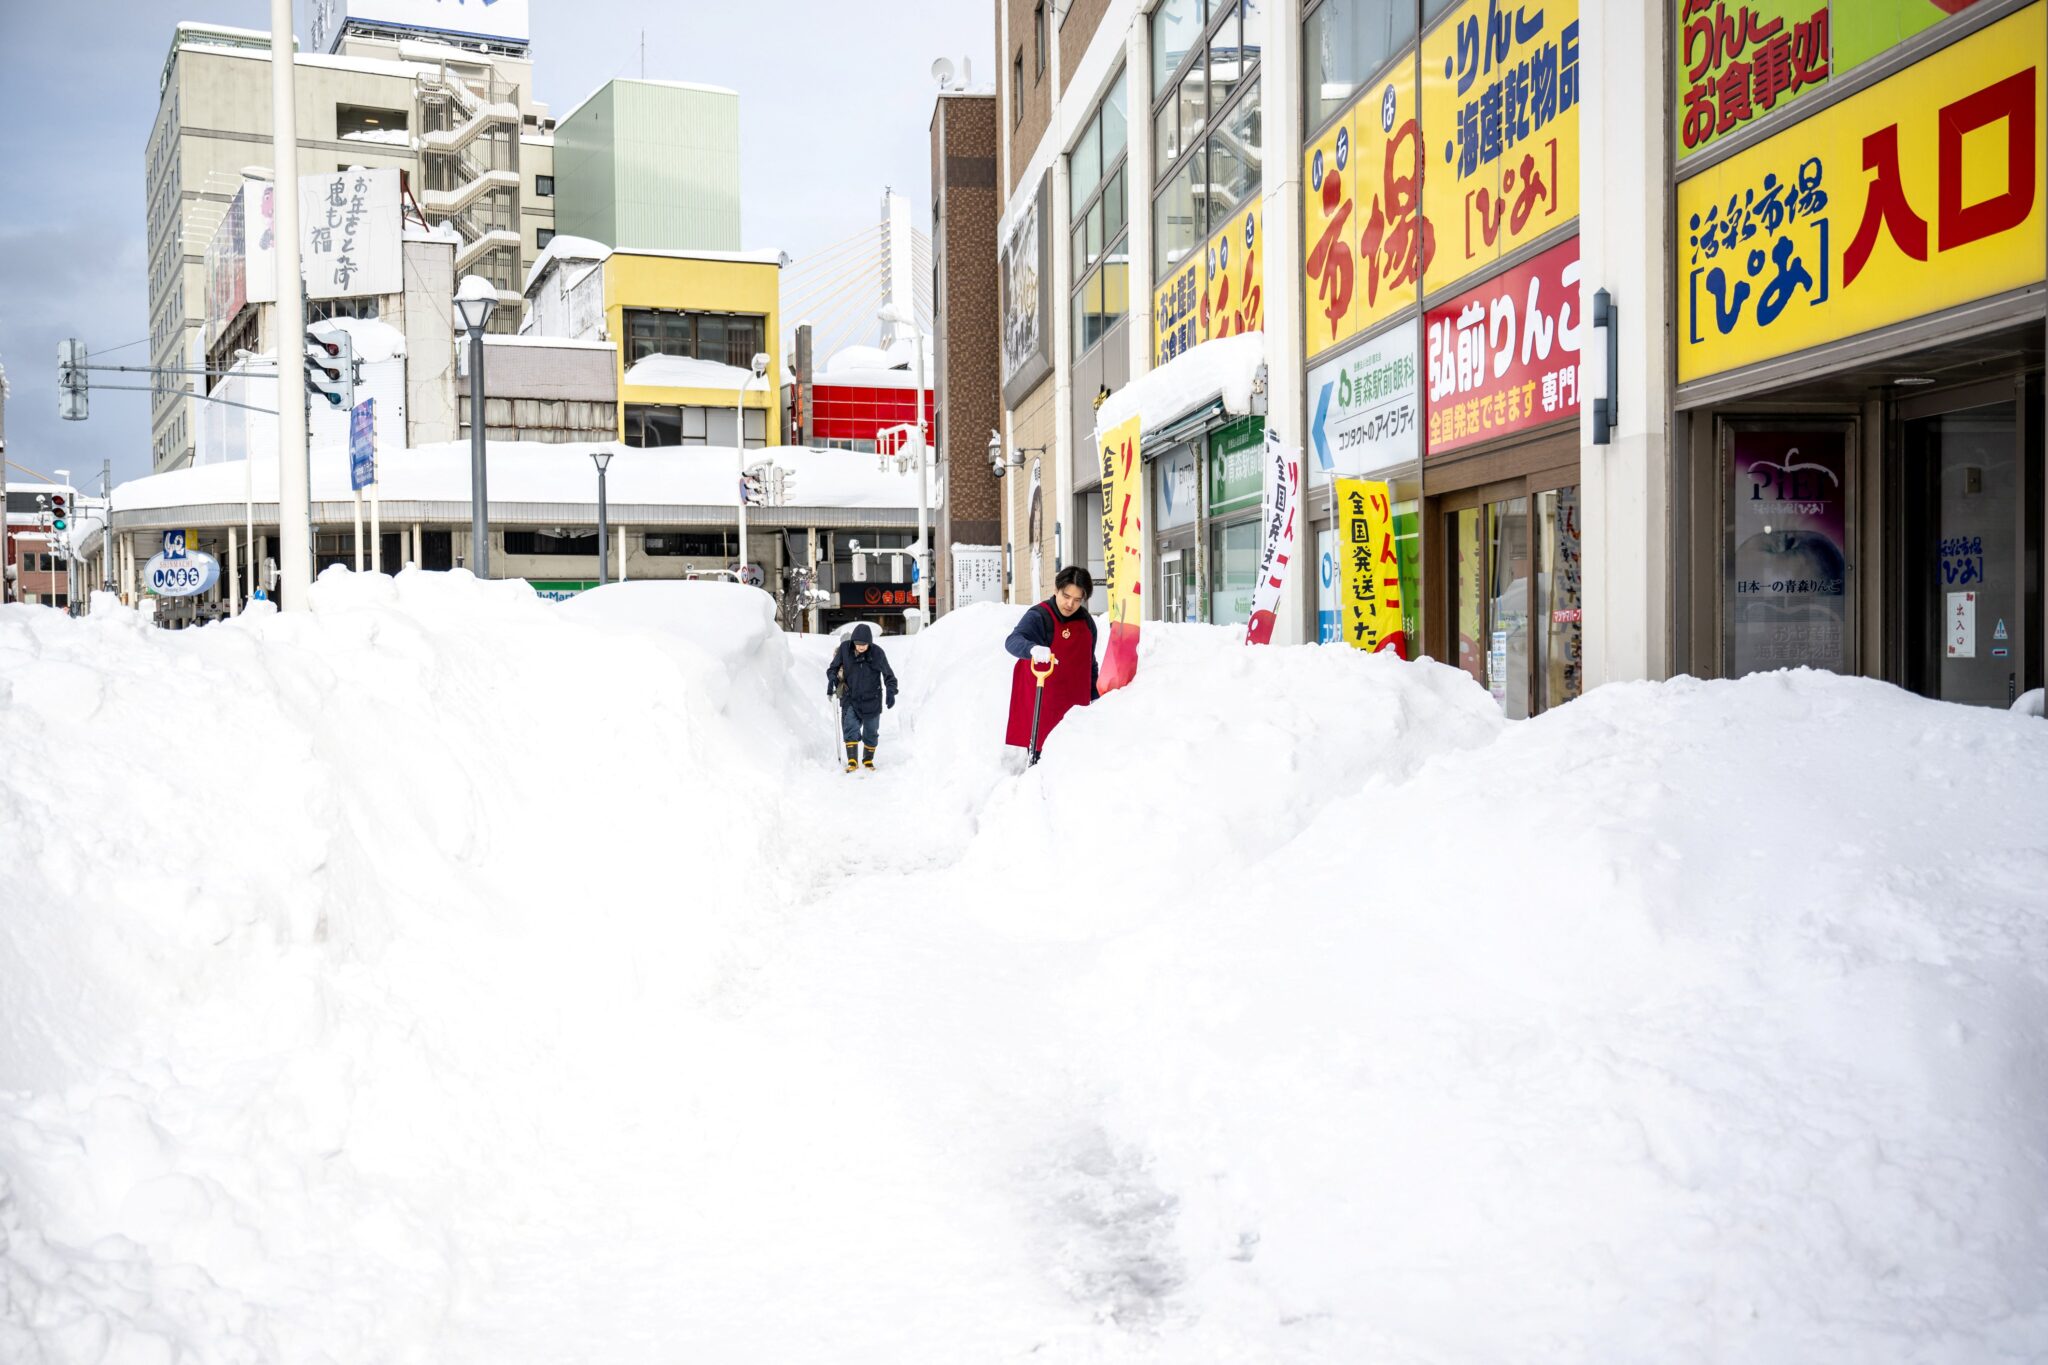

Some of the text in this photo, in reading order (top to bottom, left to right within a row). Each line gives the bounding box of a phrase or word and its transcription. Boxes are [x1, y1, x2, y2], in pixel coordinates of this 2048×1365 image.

[1457, 18, 1579, 182] 海産乾物品
[1683, 7, 1829, 148] お食事処
[1843, 65, 2036, 290] 入口
[1160, 265, 1196, 333] お土産品
[1354, 352, 1415, 408] 青森駅前眼科
[1430, 380, 1535, 446] 全国発送できます
[1541, 365, 1580, 412] 専門
[1339, 405, 1415, 451] コンタクトのアイシティ
[1102, 446, 1116, 609] 全国発送
[154, 568, 199, 587] しんまち
[1737, 579, 1842, 594] 日本一の青森りんご
